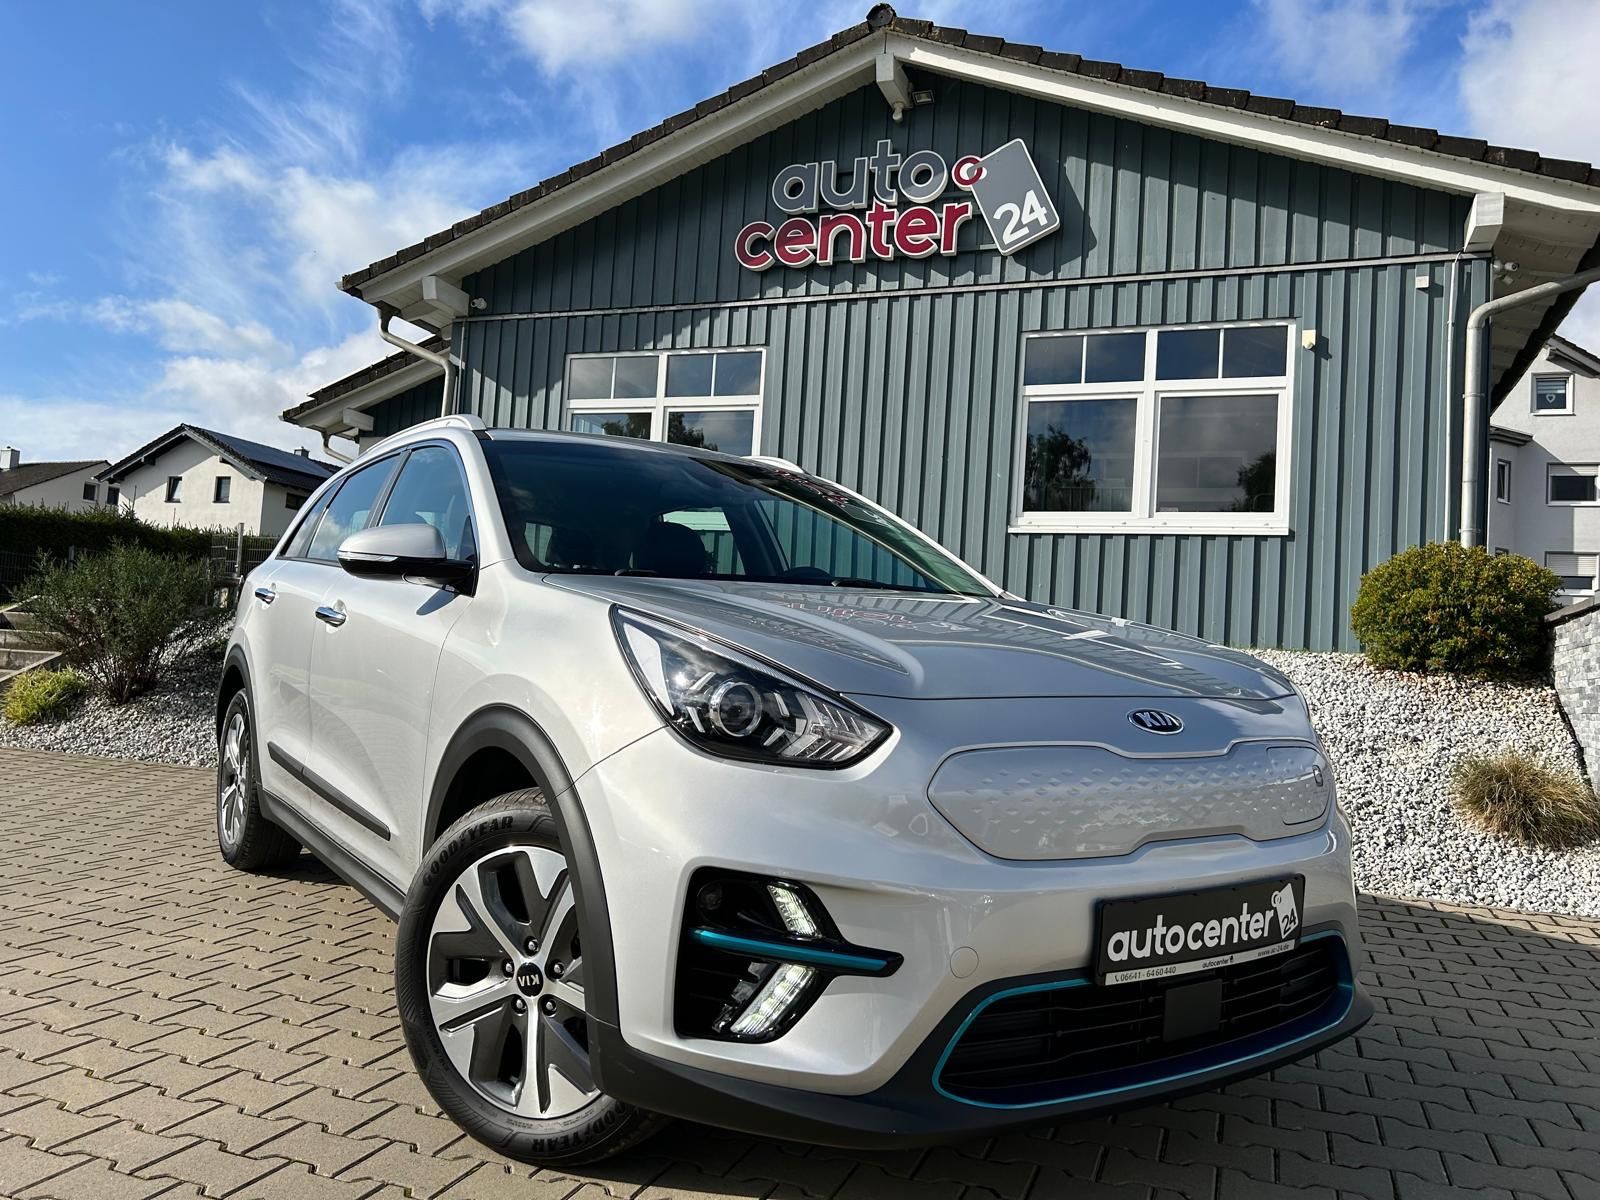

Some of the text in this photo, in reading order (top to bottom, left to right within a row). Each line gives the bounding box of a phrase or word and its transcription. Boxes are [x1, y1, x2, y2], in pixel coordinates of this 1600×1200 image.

[772, 139, 948, 214] auto
[735, 197, 972, 271] center
[992, 190, 1048, 245] 24
[1135, 711, 1180, 728] KIA
[423, 815, 514, 886] GOODYEAR
[1107, 902, 1297, 962] autocenter 24
[517, 974, 540, 987] KIA
